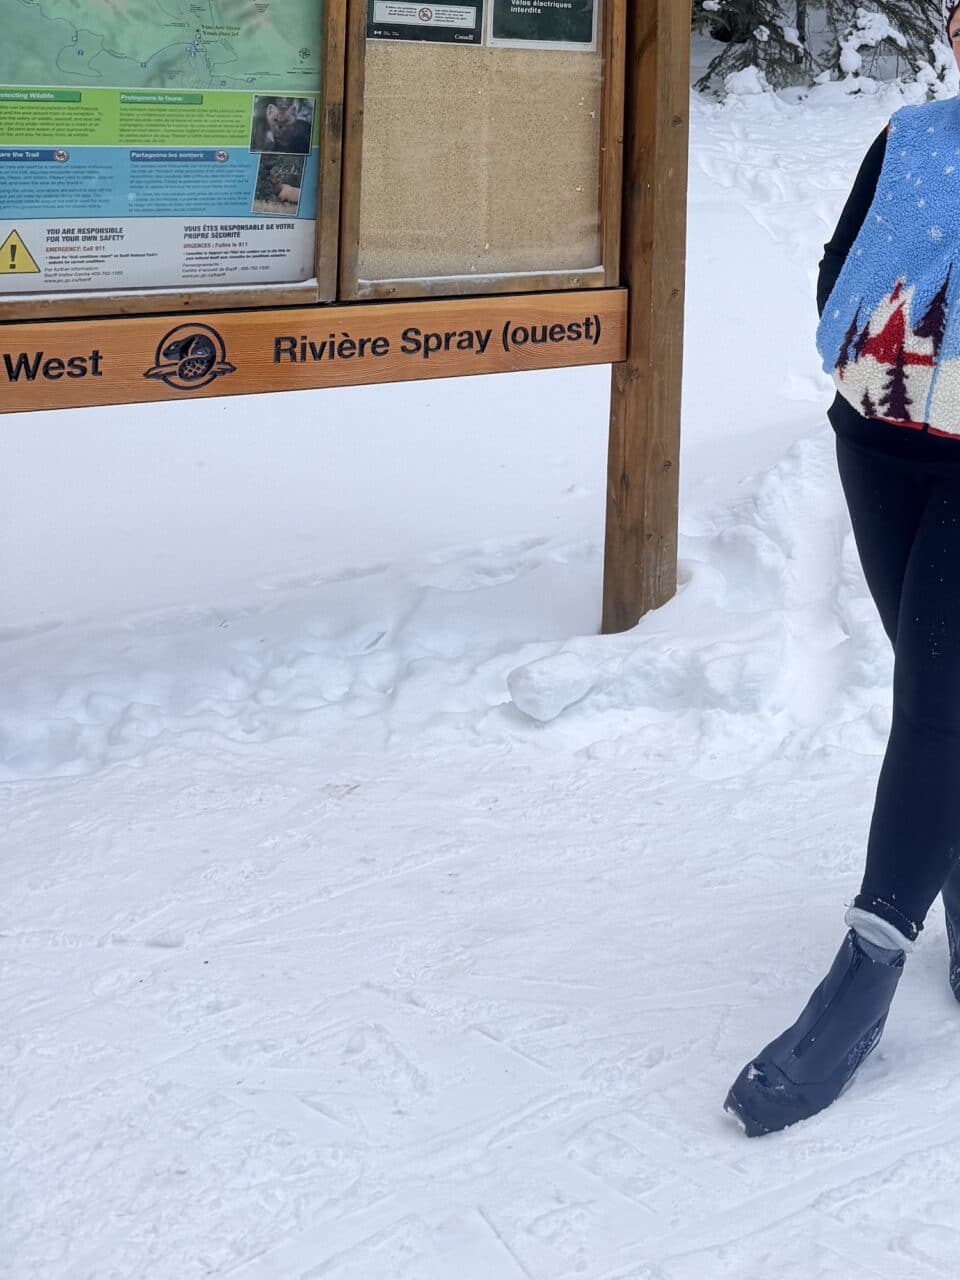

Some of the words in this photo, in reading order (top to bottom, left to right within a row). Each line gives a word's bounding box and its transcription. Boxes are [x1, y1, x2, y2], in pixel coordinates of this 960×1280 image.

[533, 0, 572, 9] électriques
[510, 6, 541, 14] interdits
[77, 227, 124, 235] RESPONSIBLE
[202, 224, 219, 232] ÊTES
[99, 234, 125, 242] SAFETY
[211, 231, 241, 239] SÉCURITÉ
[273, 332, 390, 364] Rivière
[400, 327, 492, 359] Spray
[502, 315, 601, 352] (ouest)
[3, 350, 103, 382] West
